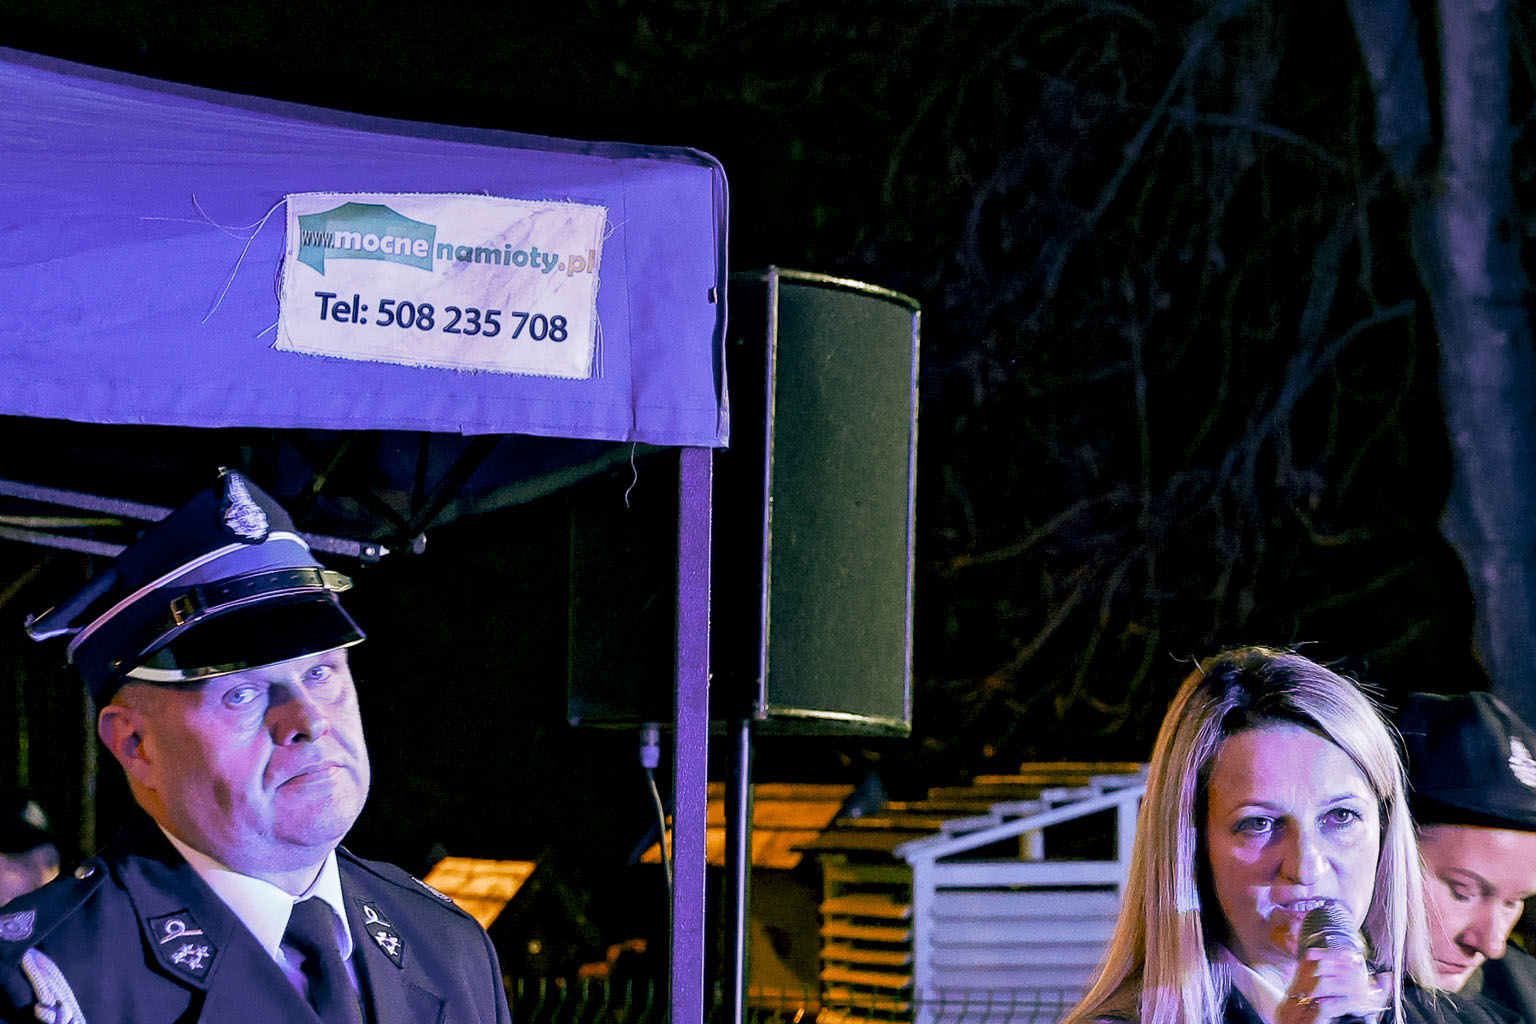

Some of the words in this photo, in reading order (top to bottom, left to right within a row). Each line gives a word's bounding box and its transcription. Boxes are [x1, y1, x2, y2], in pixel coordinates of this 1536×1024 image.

[315, 291, 368, 325] Tel:
[376, 298, 435, 331] 508
[443, 306, 502, 337] 235
[511, 312, 568, 342] 708
